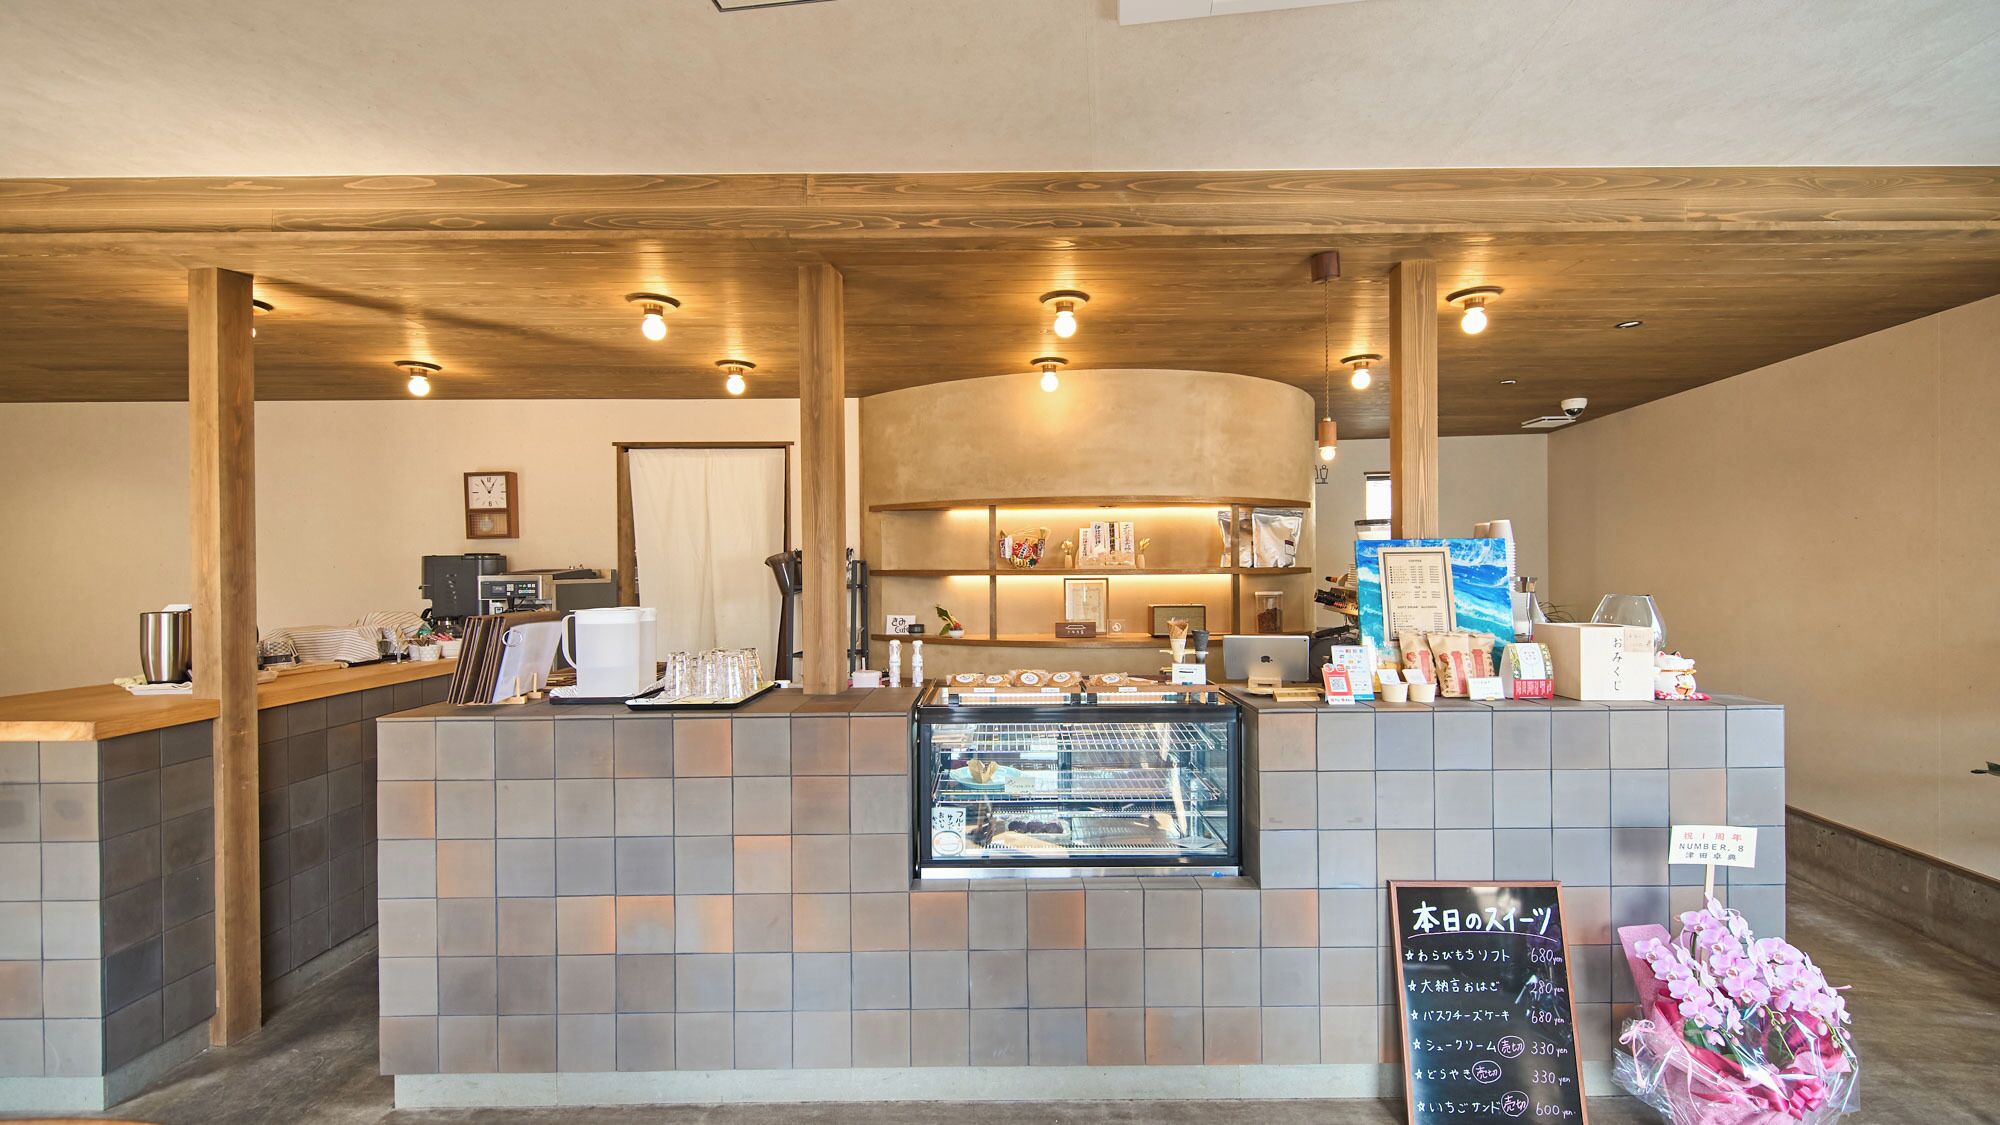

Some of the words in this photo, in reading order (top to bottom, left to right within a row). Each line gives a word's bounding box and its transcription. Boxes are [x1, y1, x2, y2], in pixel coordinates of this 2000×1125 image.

[1612, 637, 1623, 691] おみくじ
[1737, 845, 1744, 853] 8
[1412, 900, 1552, 936] 本日のスイーツ
[1417, 948, 1511, 962] わらびもちソフト
[1423, 1010, 1510, 1022] バスクチーズケーキ
[1531, 1010, 1552, 1024] 680
[1426, 1039, 1497, 1053] シュークリーム
[1501, 1040, 1523, 1054] 売切
[1530, 1041, 1555, 1055] 330
[1555, 1048, 1568, 1057] yen
[1427, 1068, 1472, 1081] どらやき
[1475, 1065, 1499, 1080] 売切
[1532, 1069, 1556, 1084] 330
[1557, 1077, 1571, 1086] yen
[1429, 1100, 1501, 1114] いちごサンド
[1503, 1095, 1526, 1112] 売切
[1535, 1101, 1560, 1116] 600
